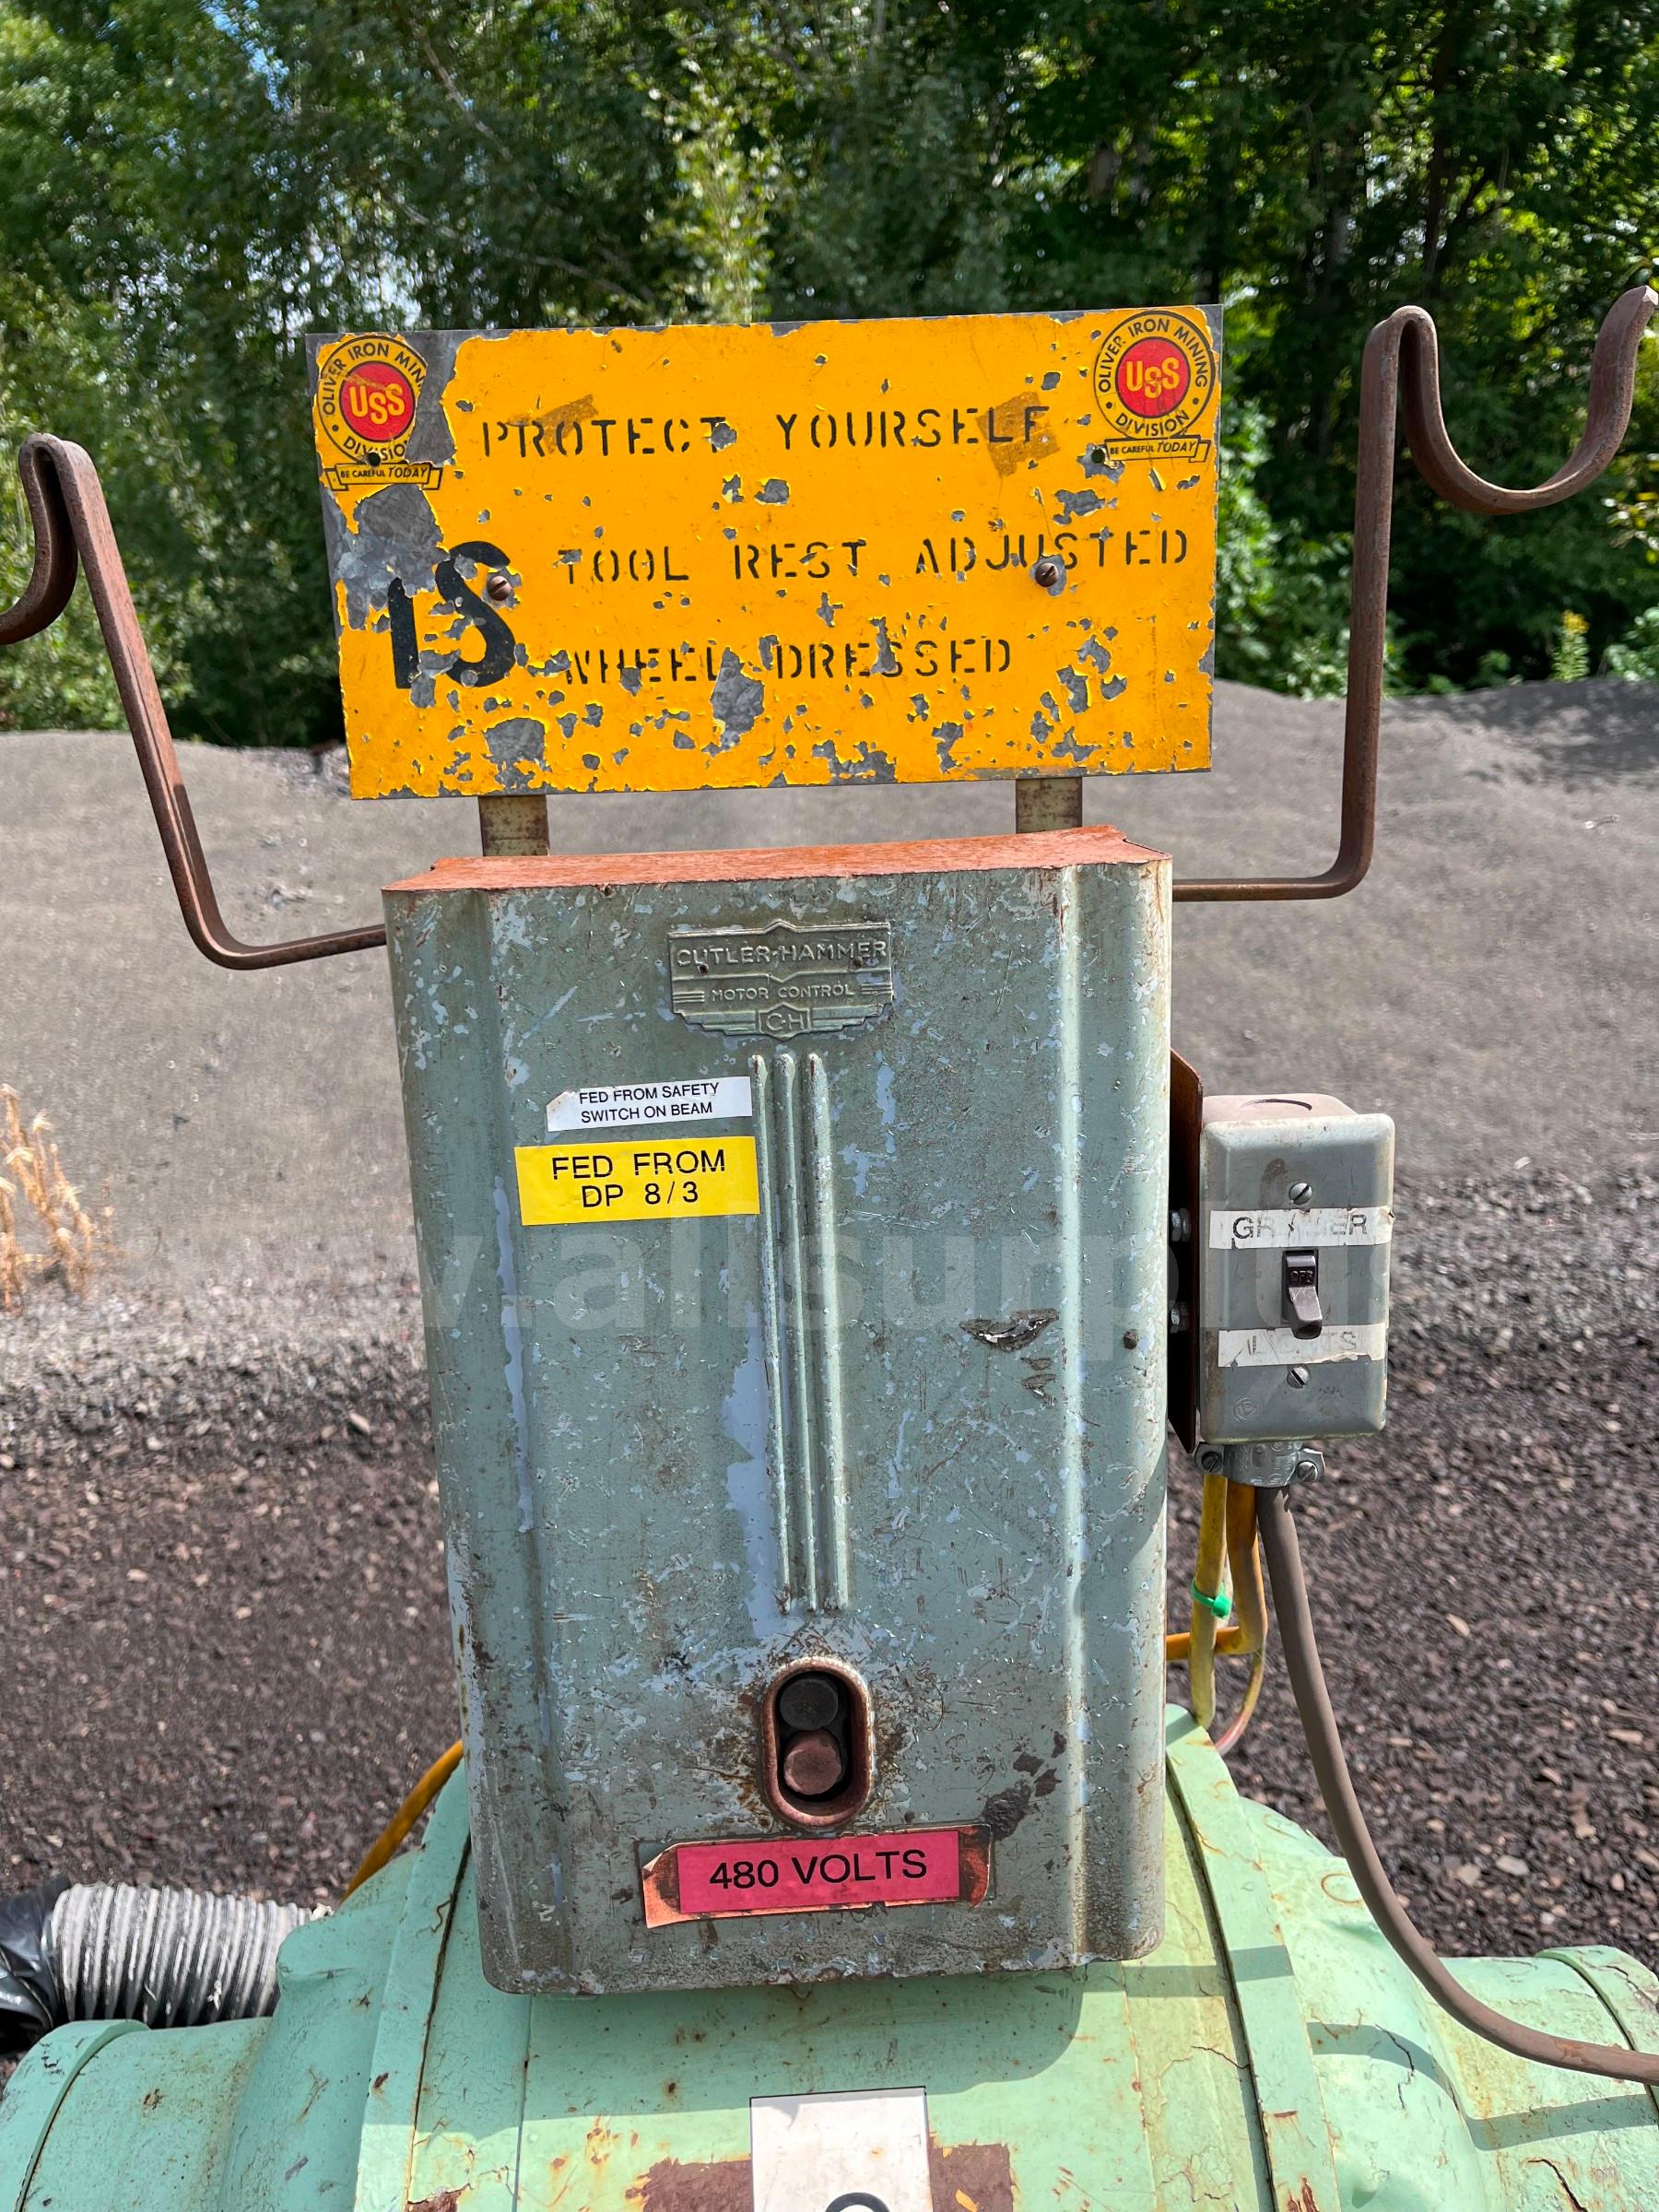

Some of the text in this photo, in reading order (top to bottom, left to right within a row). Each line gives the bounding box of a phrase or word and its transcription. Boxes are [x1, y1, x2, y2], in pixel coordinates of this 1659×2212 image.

[1098, 318, 1208, 393] OLIVER IRON MINING
[323, 358, 347, 416] OLIVER
[347, 342, 390, 360] IRON
[1125, 357, 1180, 399] USS
[348, 382, 406, 425] USS
[482, 406, 1050, 457] PROTECT YOURSELF
[1114, 409, 1190, 437] DIVISION
[1110, 441, 1197, 455] BE CAREFUL TODAY
[340, 465, 428, 478] BE CAREFUL TODAY
[558, 529, 1188, 584] TOOL REST ADJUSTED
[776, 637, 1011, 679] DRESSED
[677, 940, 888, 967] CUTLER-HAMMER
[711, 982, 855, 1002] MOTOR CONTROL
[579, 1082, 720, 1104] FED FROM SAFETY
[581, 1101, 713, 1124] SWITCH ON BEAM
[552, 1149, 726, 1180] FED FROM
[582, 1183, 624, 1208] DP
[709, 1849, 928, 1890] 480 VOLTS
